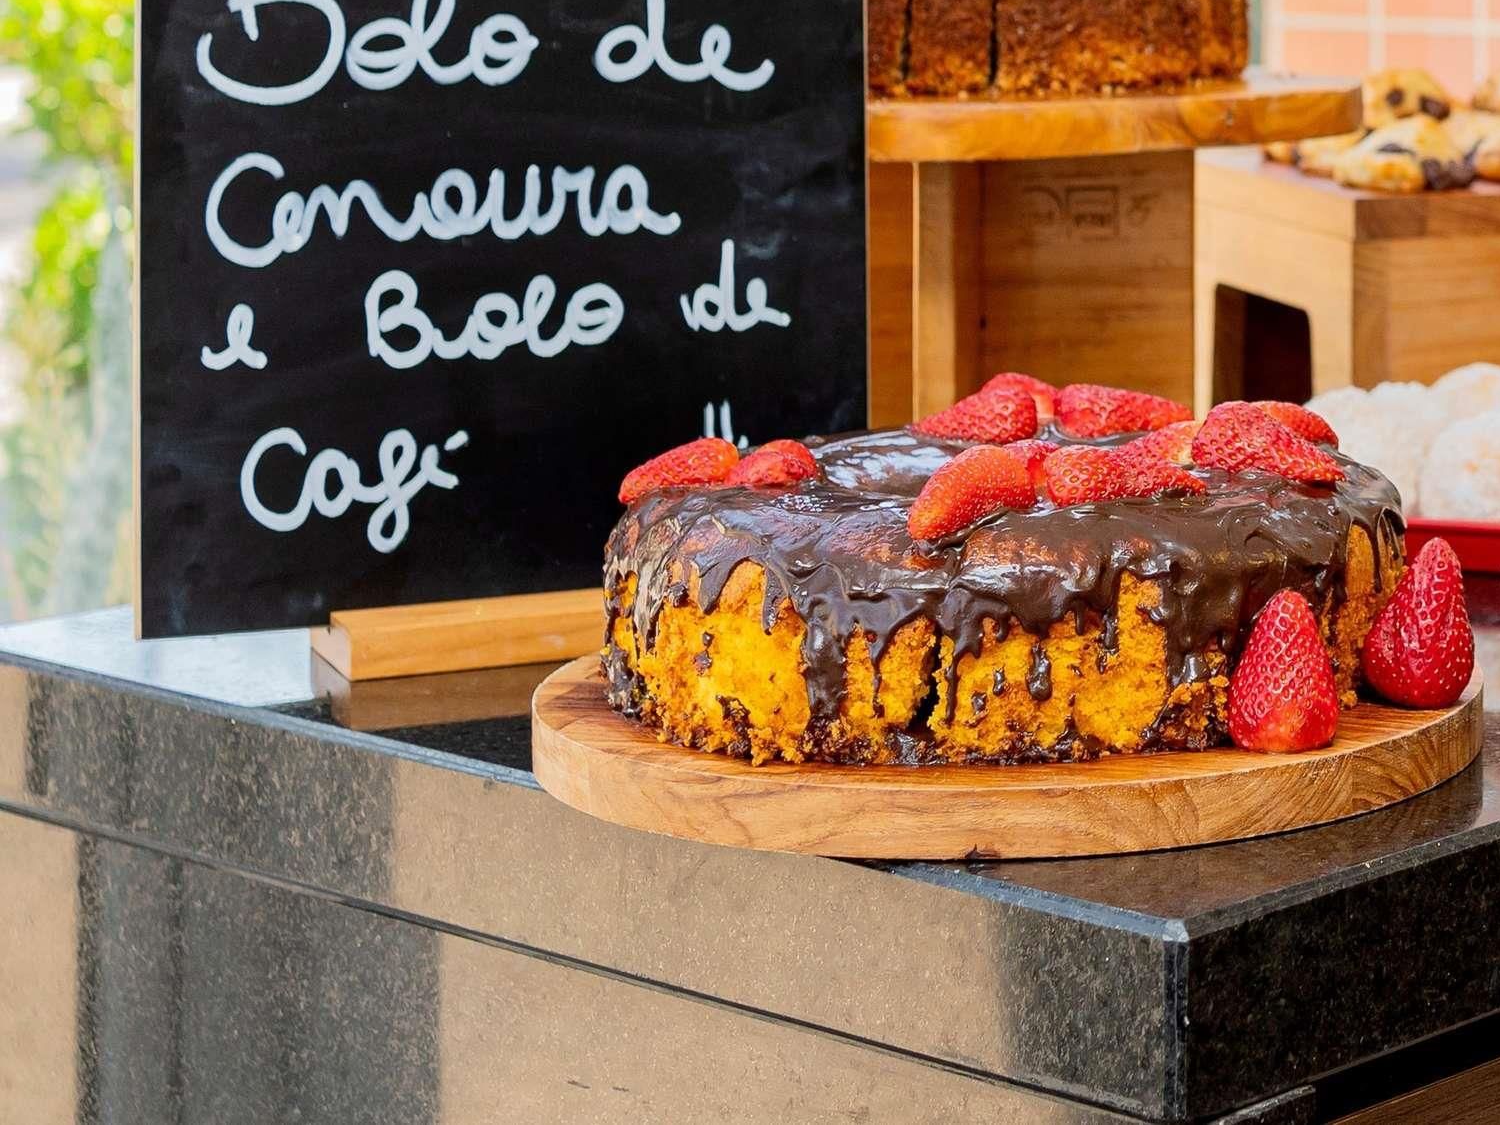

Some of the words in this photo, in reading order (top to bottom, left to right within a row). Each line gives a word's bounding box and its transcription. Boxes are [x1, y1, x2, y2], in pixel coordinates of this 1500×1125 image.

[206, 152, 681, 268] Cenoura
[200, 303, 268, 370] e
[364, 270, 624, 368] Bolo
[680, 239, 791, 332] de
[240, 427, 470, 553] Café
